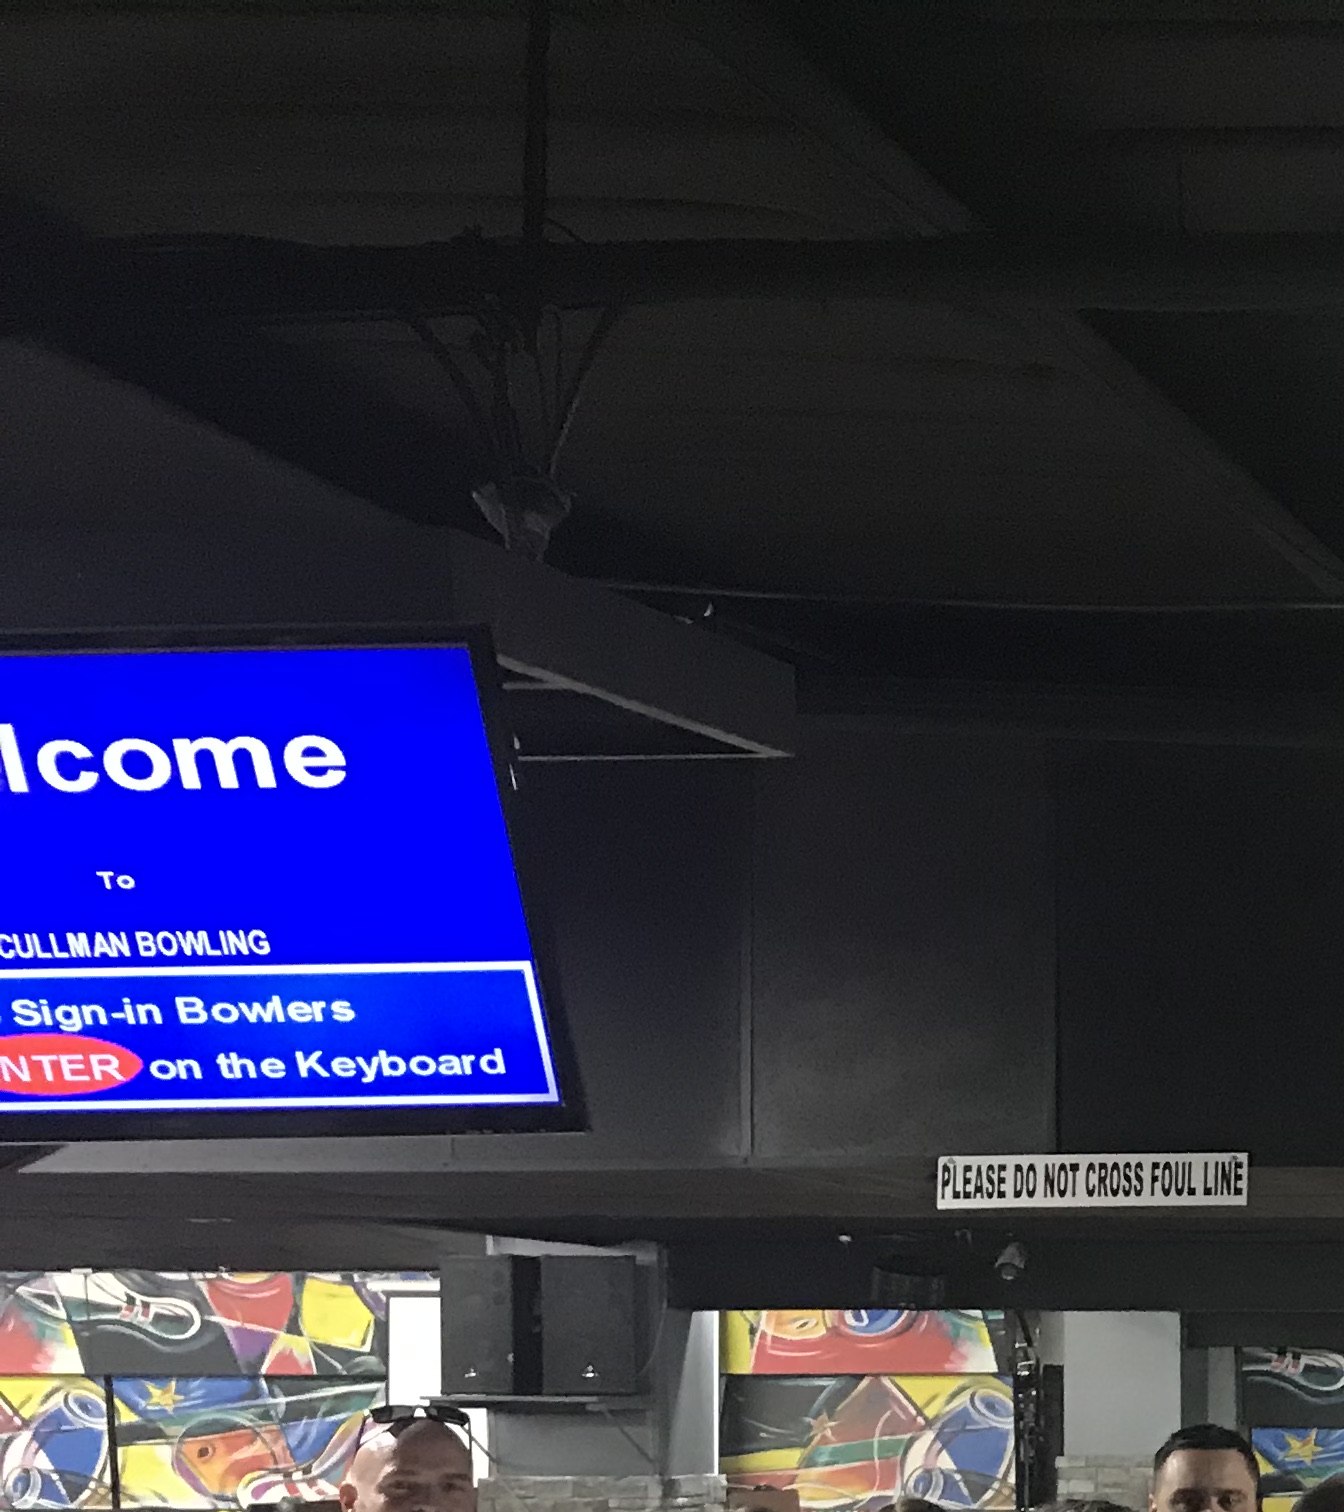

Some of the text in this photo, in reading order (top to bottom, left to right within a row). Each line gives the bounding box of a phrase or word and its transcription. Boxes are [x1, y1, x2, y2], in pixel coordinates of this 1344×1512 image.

[96, 871, 136, 890] To
[0, 929, 271, 959] CULLMAN BOWLING
[11, 995, 356, 1032] Sign-in Bowlers
[149, 1059, 202, 1080] on
[216, 1052, 286, 1079] the
[295, 1048, 506, 1083] Keyboard
[940, 1160, 1245, 1200] PLEASE DO NOT CROSS FOUL LINE
